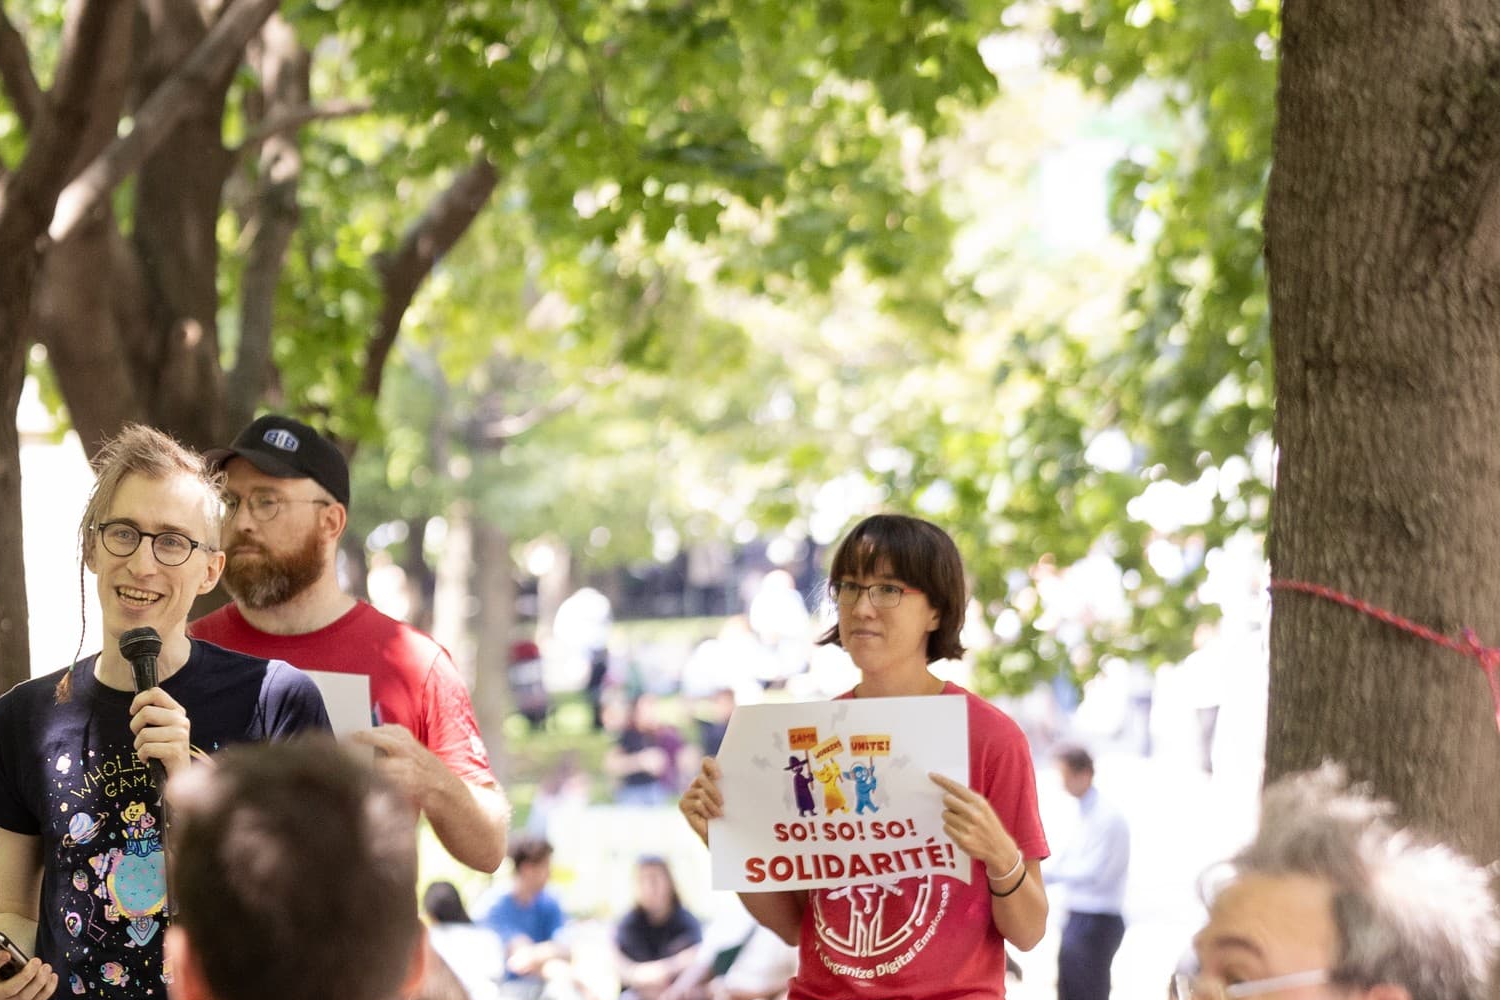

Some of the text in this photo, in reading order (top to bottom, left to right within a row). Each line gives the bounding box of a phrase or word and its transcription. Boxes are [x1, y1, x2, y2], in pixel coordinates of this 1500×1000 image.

[789, 733, 817, 745] GAME
[850, 740, 891, 752] UNITE!
[773, 818, 917, 842] SO! SO! SO!
[745, 837, 956, 884] SOLIDARITÉ!
[823, 882, 950, 980] Organize Digital Employees
